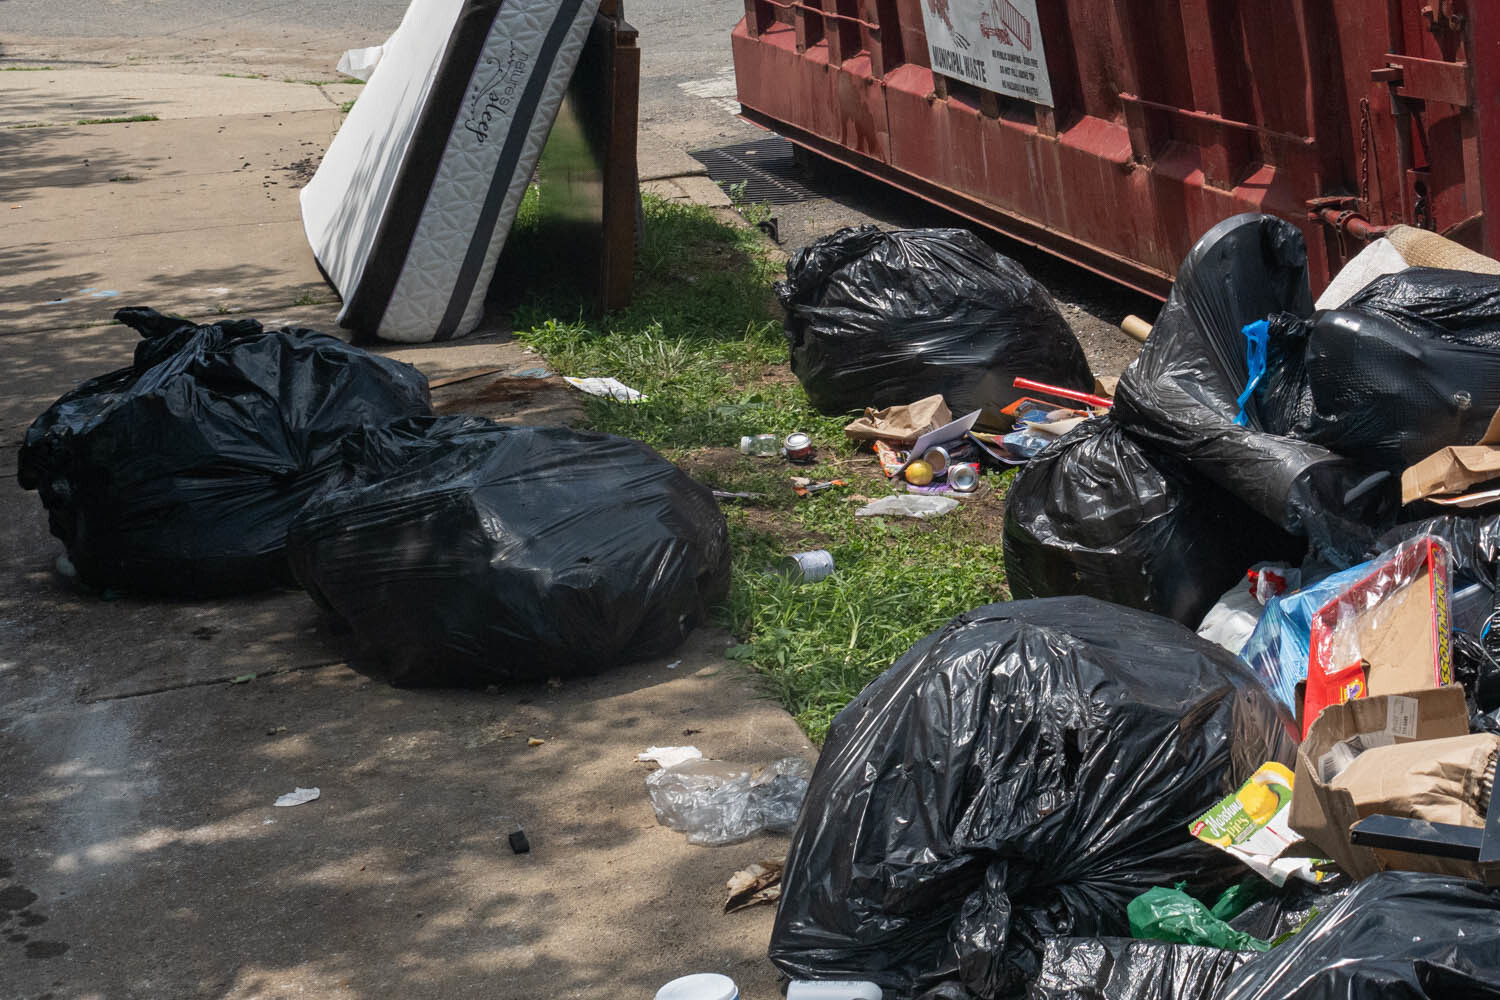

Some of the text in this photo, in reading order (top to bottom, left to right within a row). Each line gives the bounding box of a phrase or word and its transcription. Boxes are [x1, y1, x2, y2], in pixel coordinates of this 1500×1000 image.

[498, 50, 530, 107] nature's
[931, 45, 987, 84] MUNICIPAL WASTE
[464, 89, 507, 145] sleep
[1434, 571, 1451, 687] SSORTMENT
[1226, 815, 1250, 838] pies
